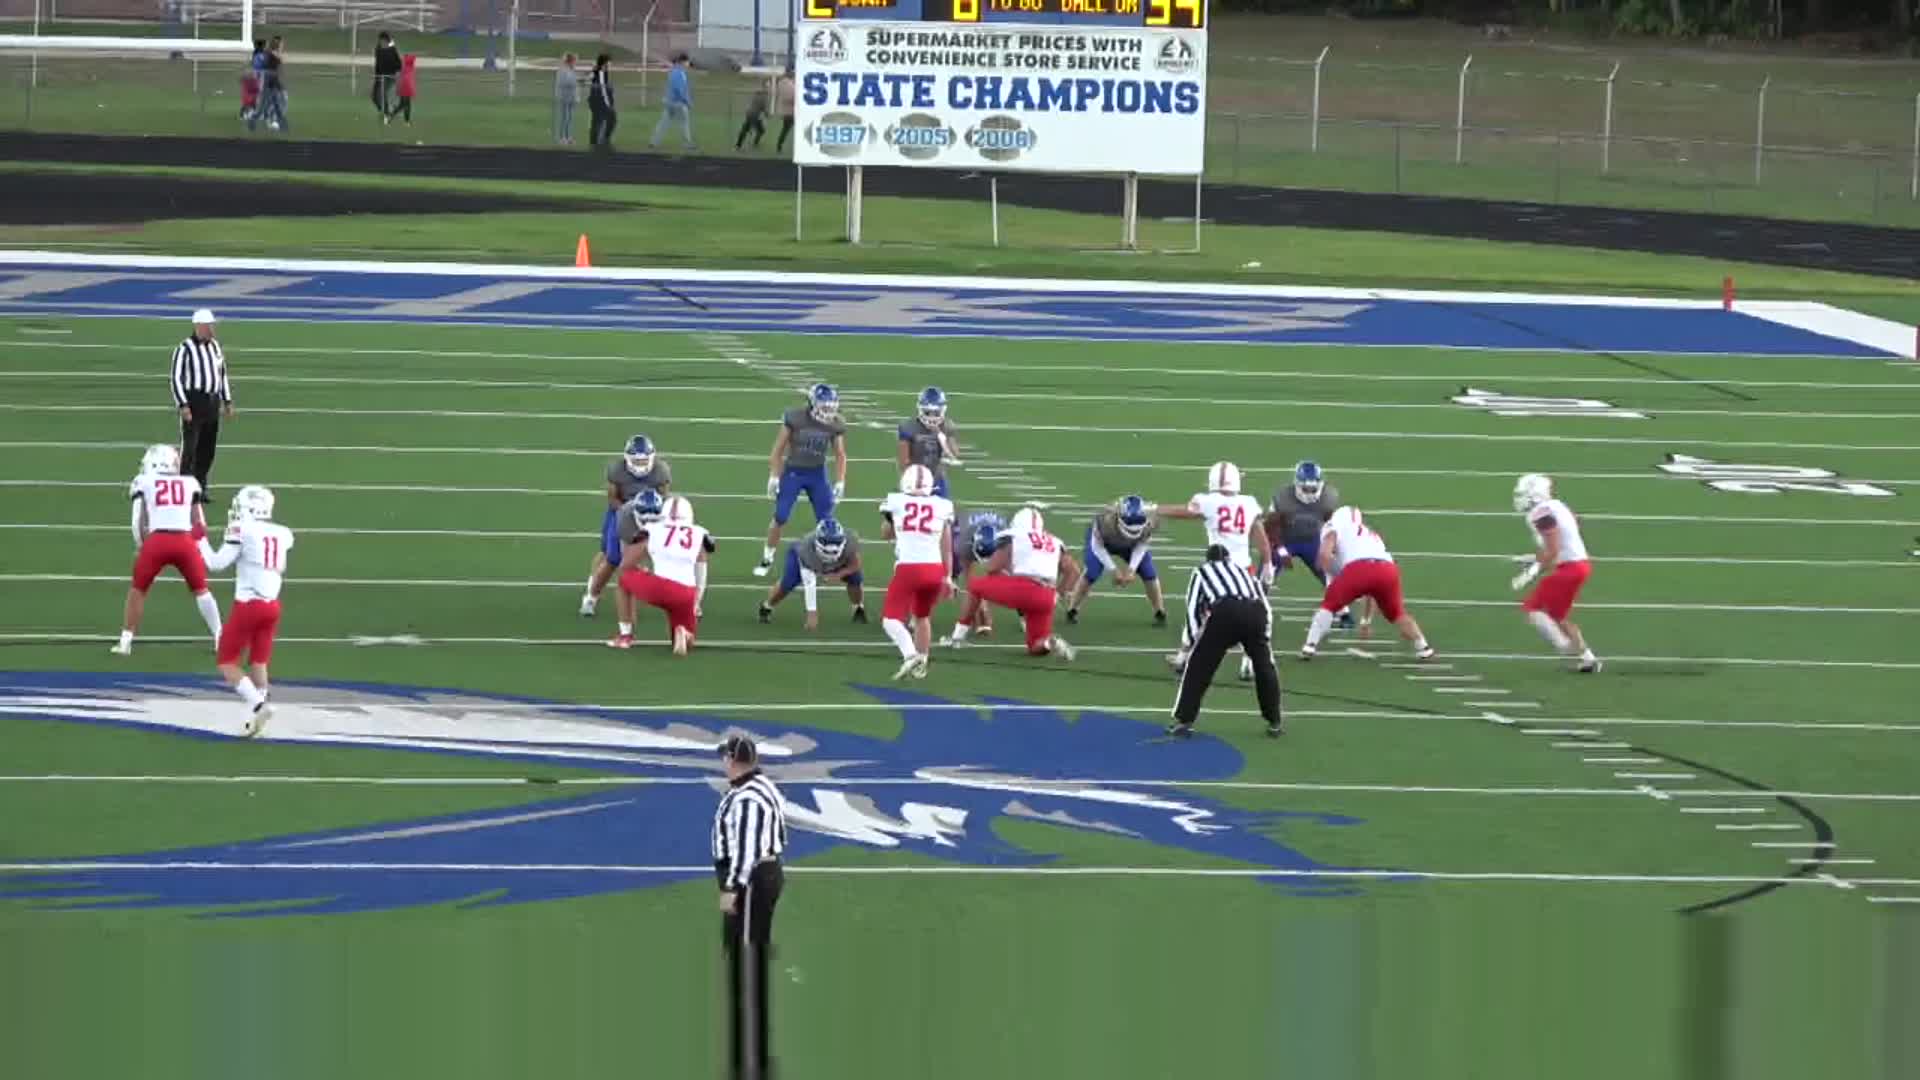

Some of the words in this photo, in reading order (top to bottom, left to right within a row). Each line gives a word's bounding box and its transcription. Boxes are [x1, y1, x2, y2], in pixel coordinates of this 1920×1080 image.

[865, 31, 1011, 50] SUPERMARKET
[1018, 35, 1087, 50] PRICES
[1092, 37, 1142, 52] WITH
[865, 50, 997, 67] CONVENIENCE
[1004, 53, 1061, 68] STORE
[1067, 55, 1141, 71] SERVICE
[802, 72, 936, 107] STATE
[947, 76, 1200, 114] CHAMPIONS
[815, 125, 866, 145] 1997
[893, 127, 949, 146] 2005
[154, 480, 185, 506] 20
[902, 502, 935, 534] 22
[1217, 504, 1246, 534] 24
[663, 524, 693, 550] 73
[262, 536, 279, 569] 11
